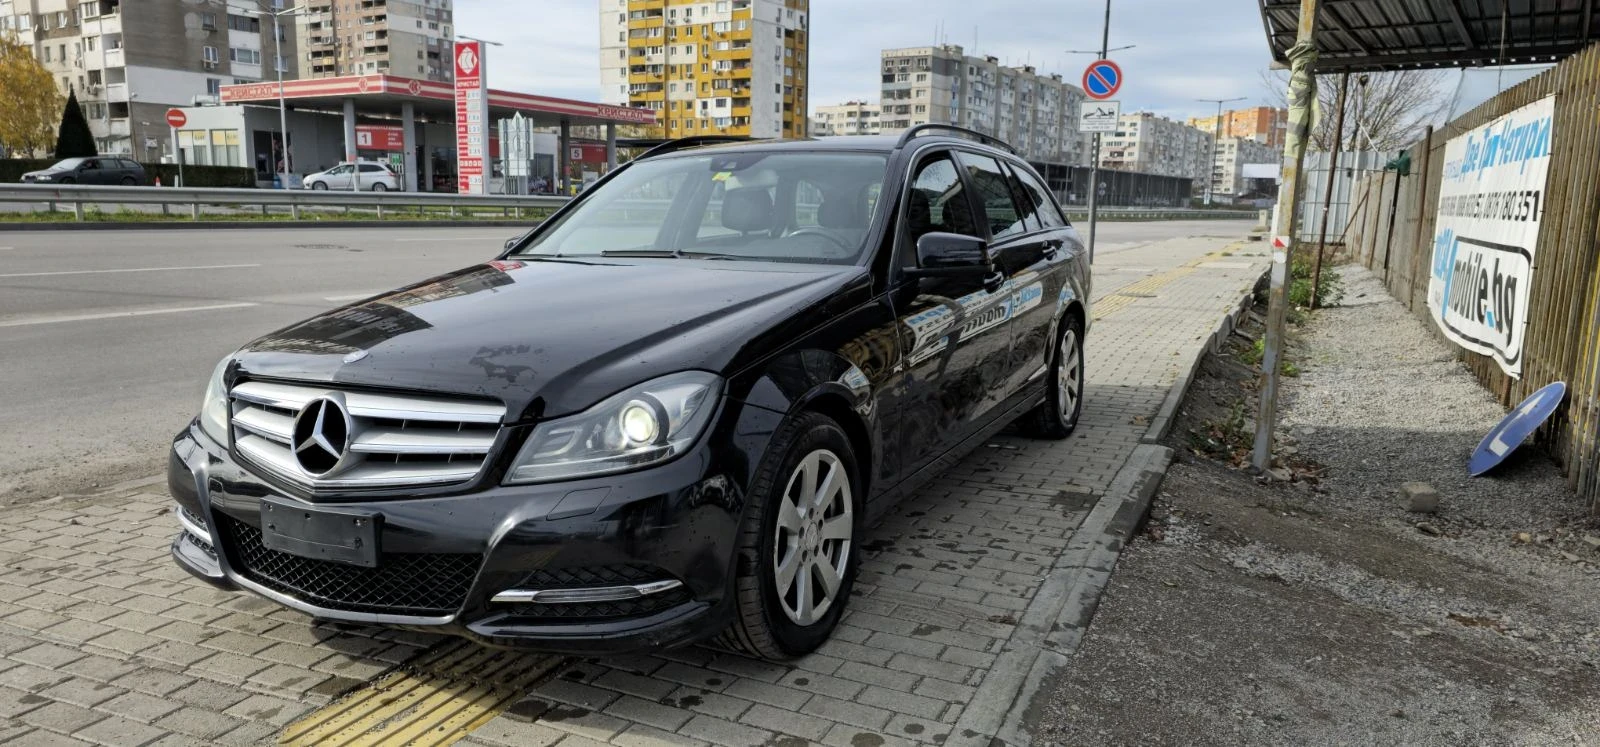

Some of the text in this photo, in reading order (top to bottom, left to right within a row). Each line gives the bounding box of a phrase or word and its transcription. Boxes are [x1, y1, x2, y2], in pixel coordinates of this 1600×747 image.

[230, 85, 272, 98] КРИСТАЛ
[598, 106, 643, 120] КРИСТАЛ
[1499, 117, 1551, 175] Четири
[1514, 190, 1540, 221] 351
[1448, 251, 1517, 349] mobile.bg
